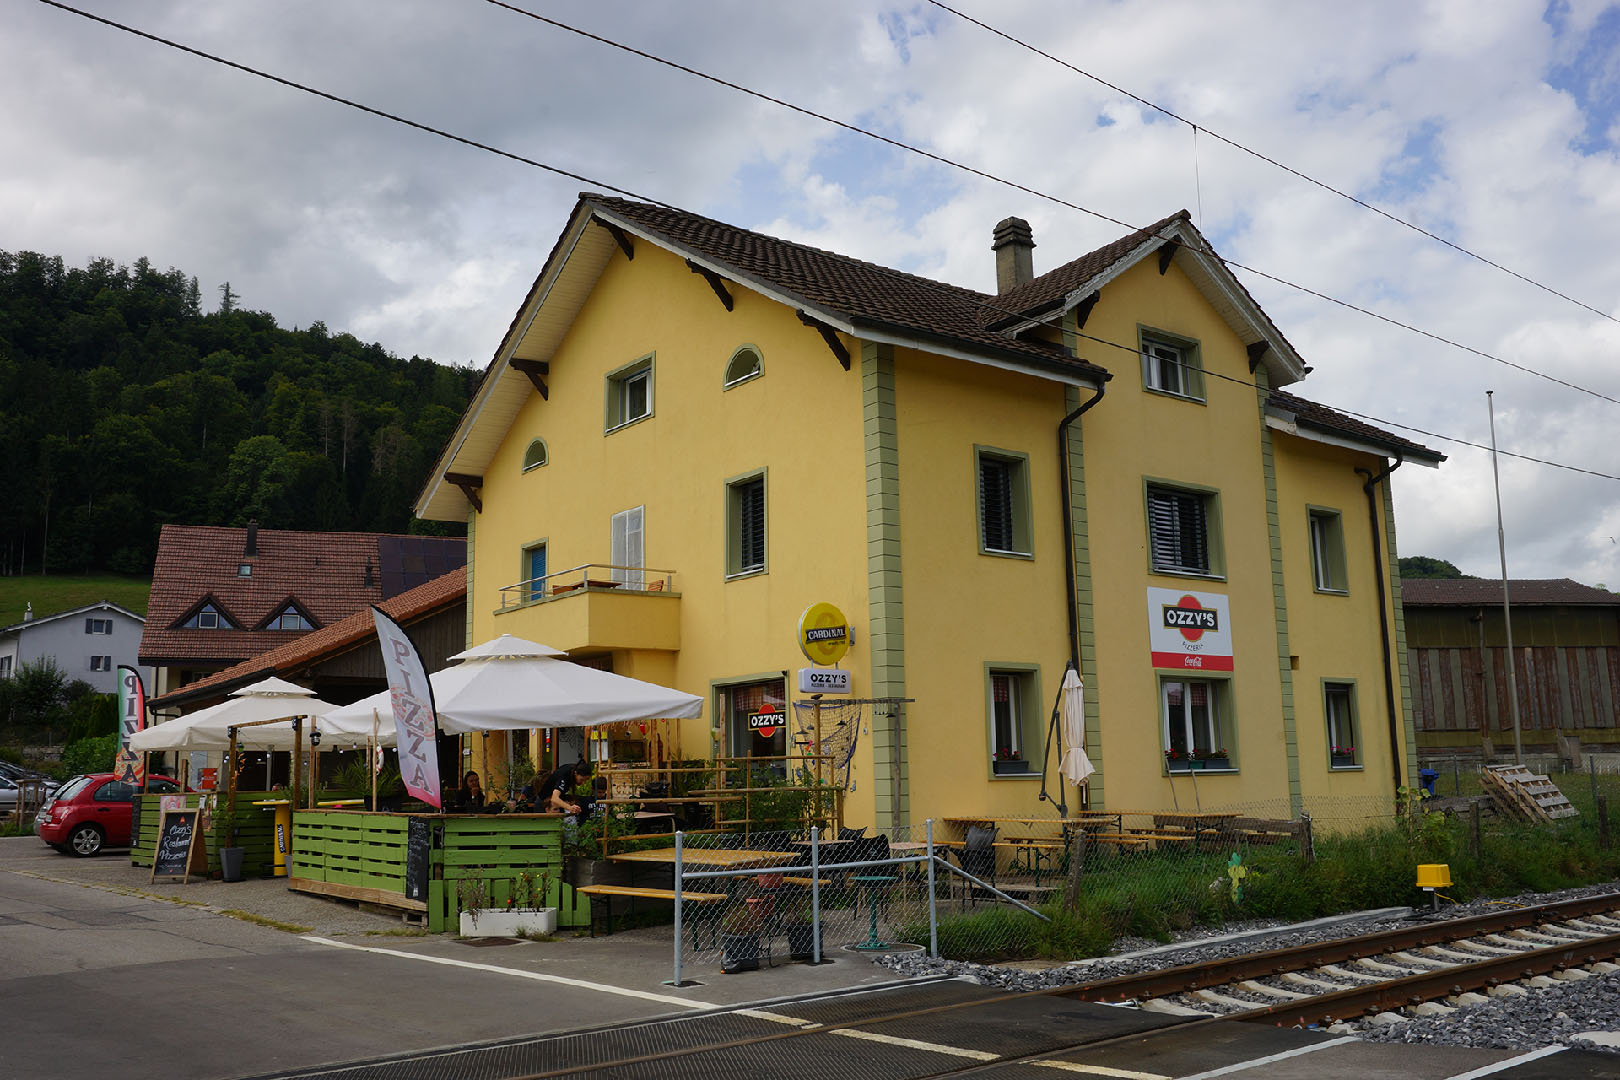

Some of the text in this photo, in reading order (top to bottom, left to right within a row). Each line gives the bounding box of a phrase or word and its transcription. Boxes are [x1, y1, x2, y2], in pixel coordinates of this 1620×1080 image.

[1167, 609, 1215, 627] OZZY'S
[808, 628, 845, 640] CARDINAL
[811, 673, 846, 683] OZZY'S
[389, 636, 433, 794] PIZZA
[751, 714, 784, 727] OZZY'S
